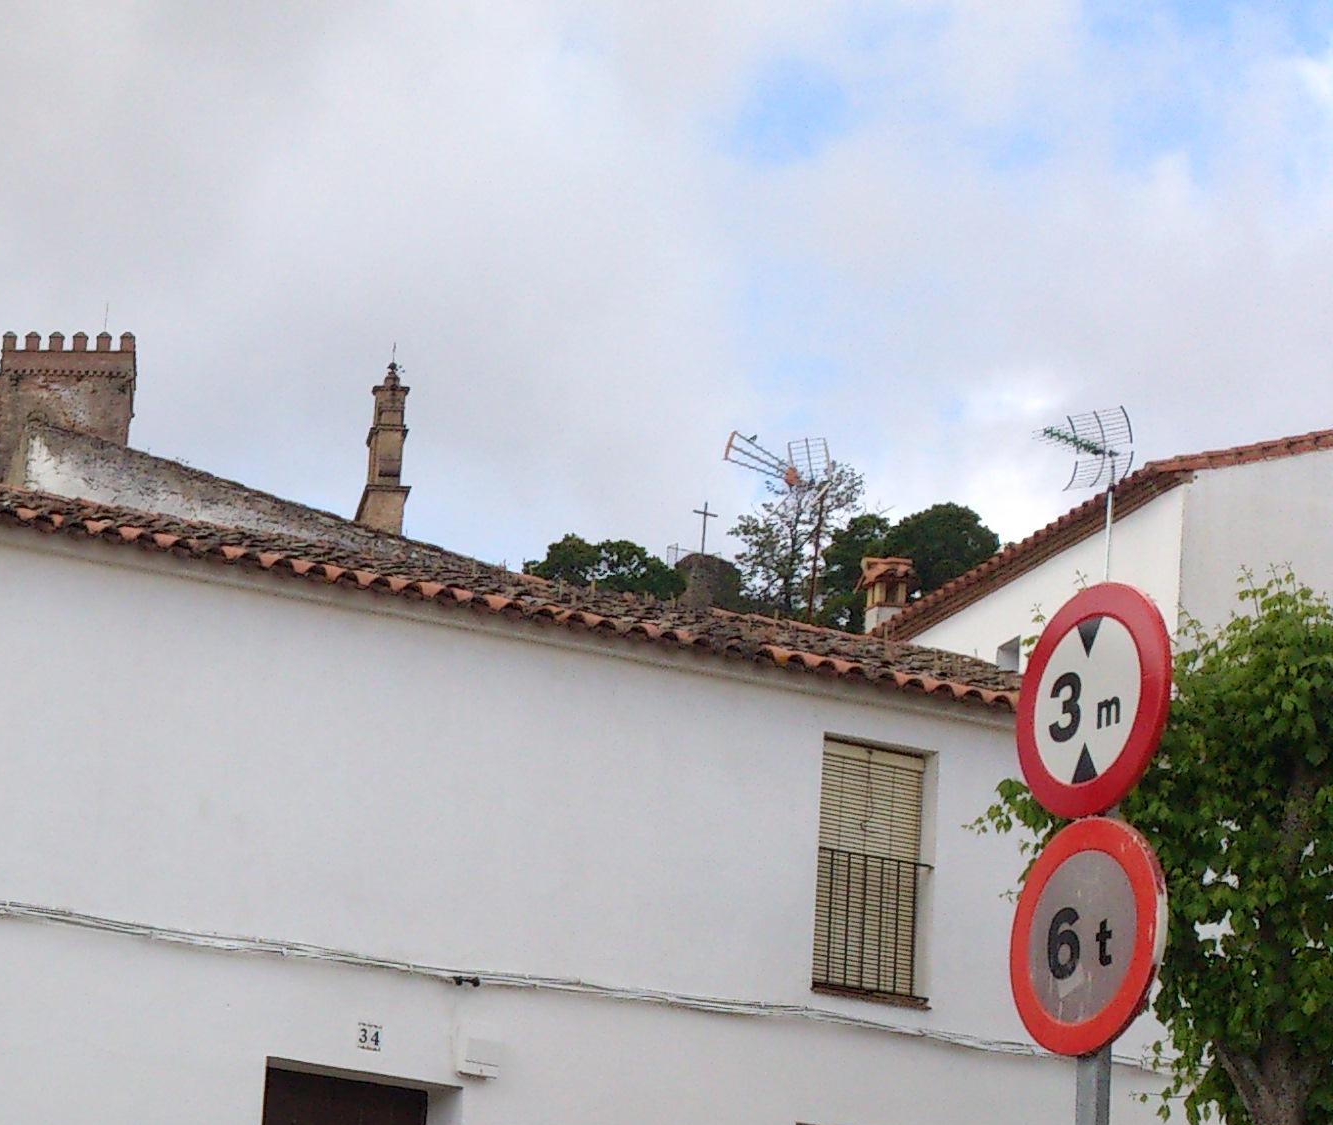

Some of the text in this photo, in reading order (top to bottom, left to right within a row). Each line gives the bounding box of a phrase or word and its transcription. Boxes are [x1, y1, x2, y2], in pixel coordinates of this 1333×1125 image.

[1049, 671, 1121, 743] 3 m
[1048, 906, 1113, 980] 6 t
[359, 1028, 380, 1046] 34
